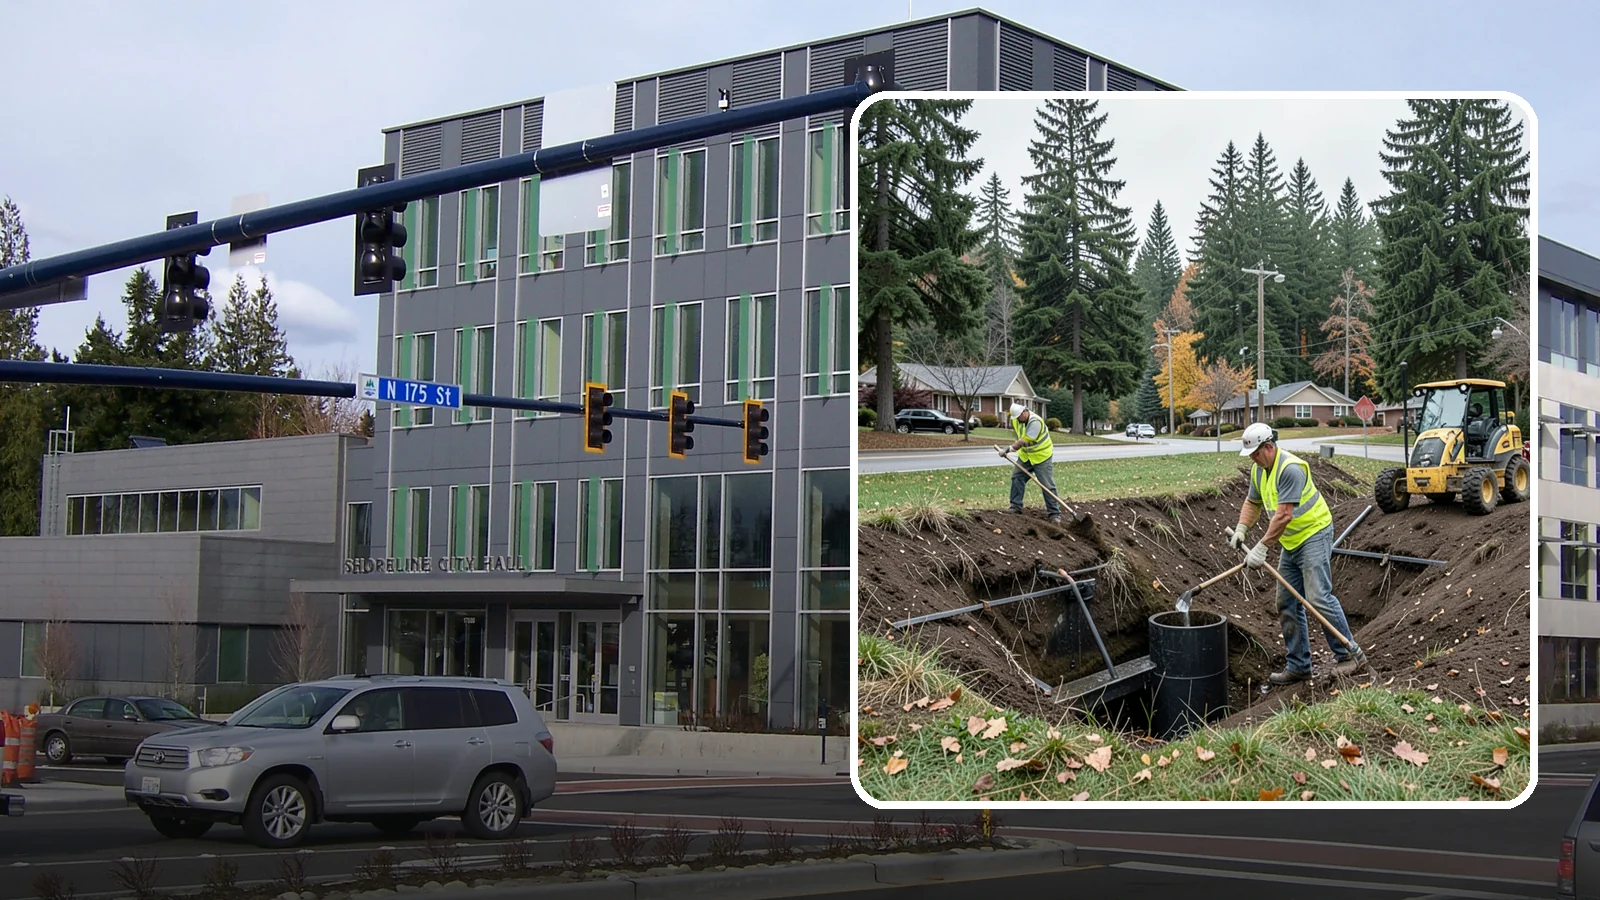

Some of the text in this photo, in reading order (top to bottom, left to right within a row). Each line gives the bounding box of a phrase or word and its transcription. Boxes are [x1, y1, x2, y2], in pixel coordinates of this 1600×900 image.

[387, 380, 451, 406] N 175 St
[344, 555, 525, 574] SHORELINE CITY HALL
